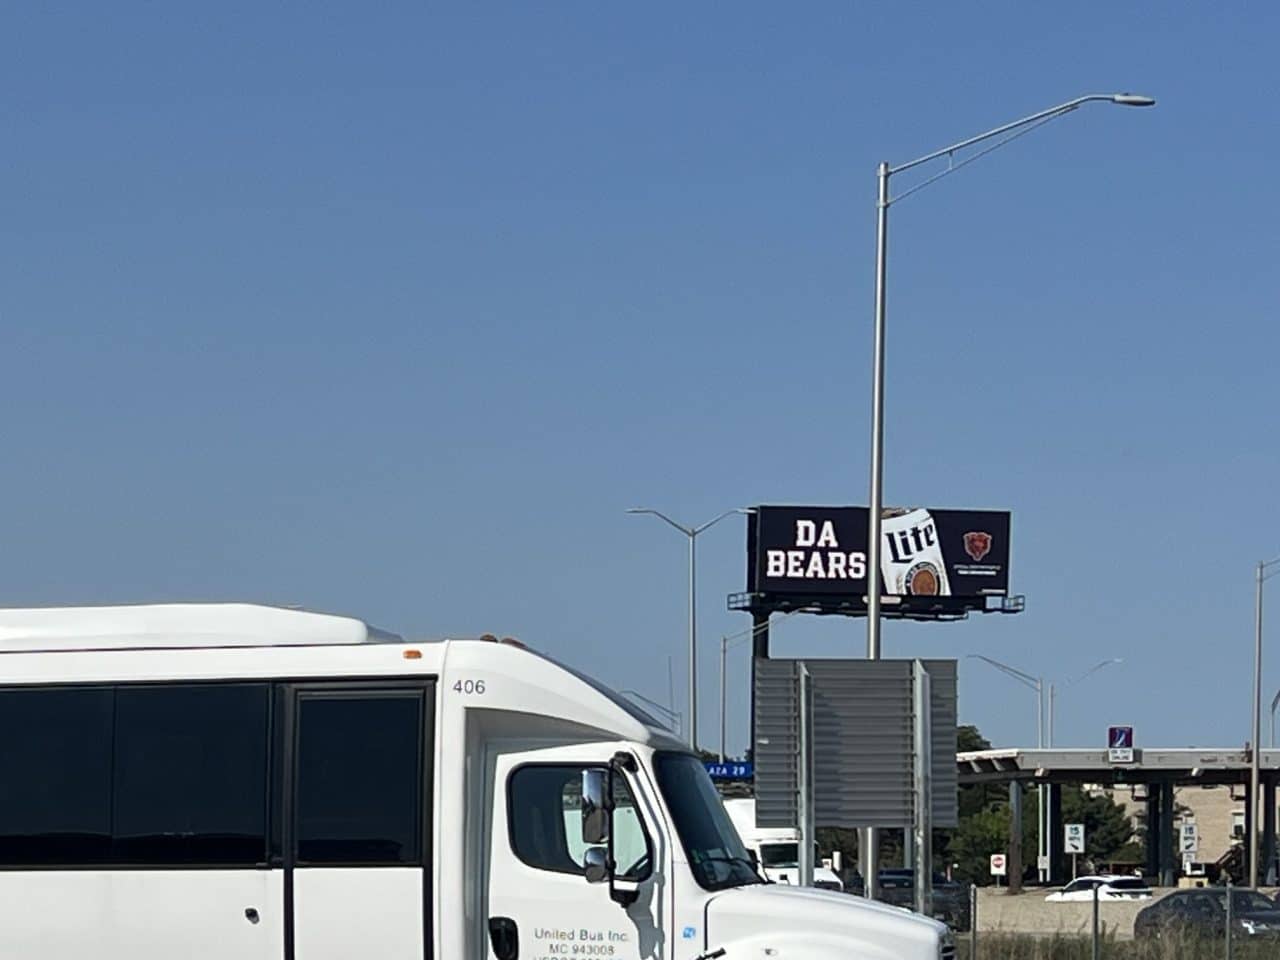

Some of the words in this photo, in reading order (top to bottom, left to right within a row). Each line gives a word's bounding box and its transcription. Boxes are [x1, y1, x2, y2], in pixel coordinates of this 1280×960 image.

[796, 520, 839, 548] DA
[884, 523, 936, 564] Lite
[766, 550, 866, 579] BEARS
[452, 679, 486, 695] 406
[534, 928, 575, 941] United
[580, 929, 604, 941] Bus
[549, 943, 568, 954] MC
[572, 944, 615, 956] 943008
